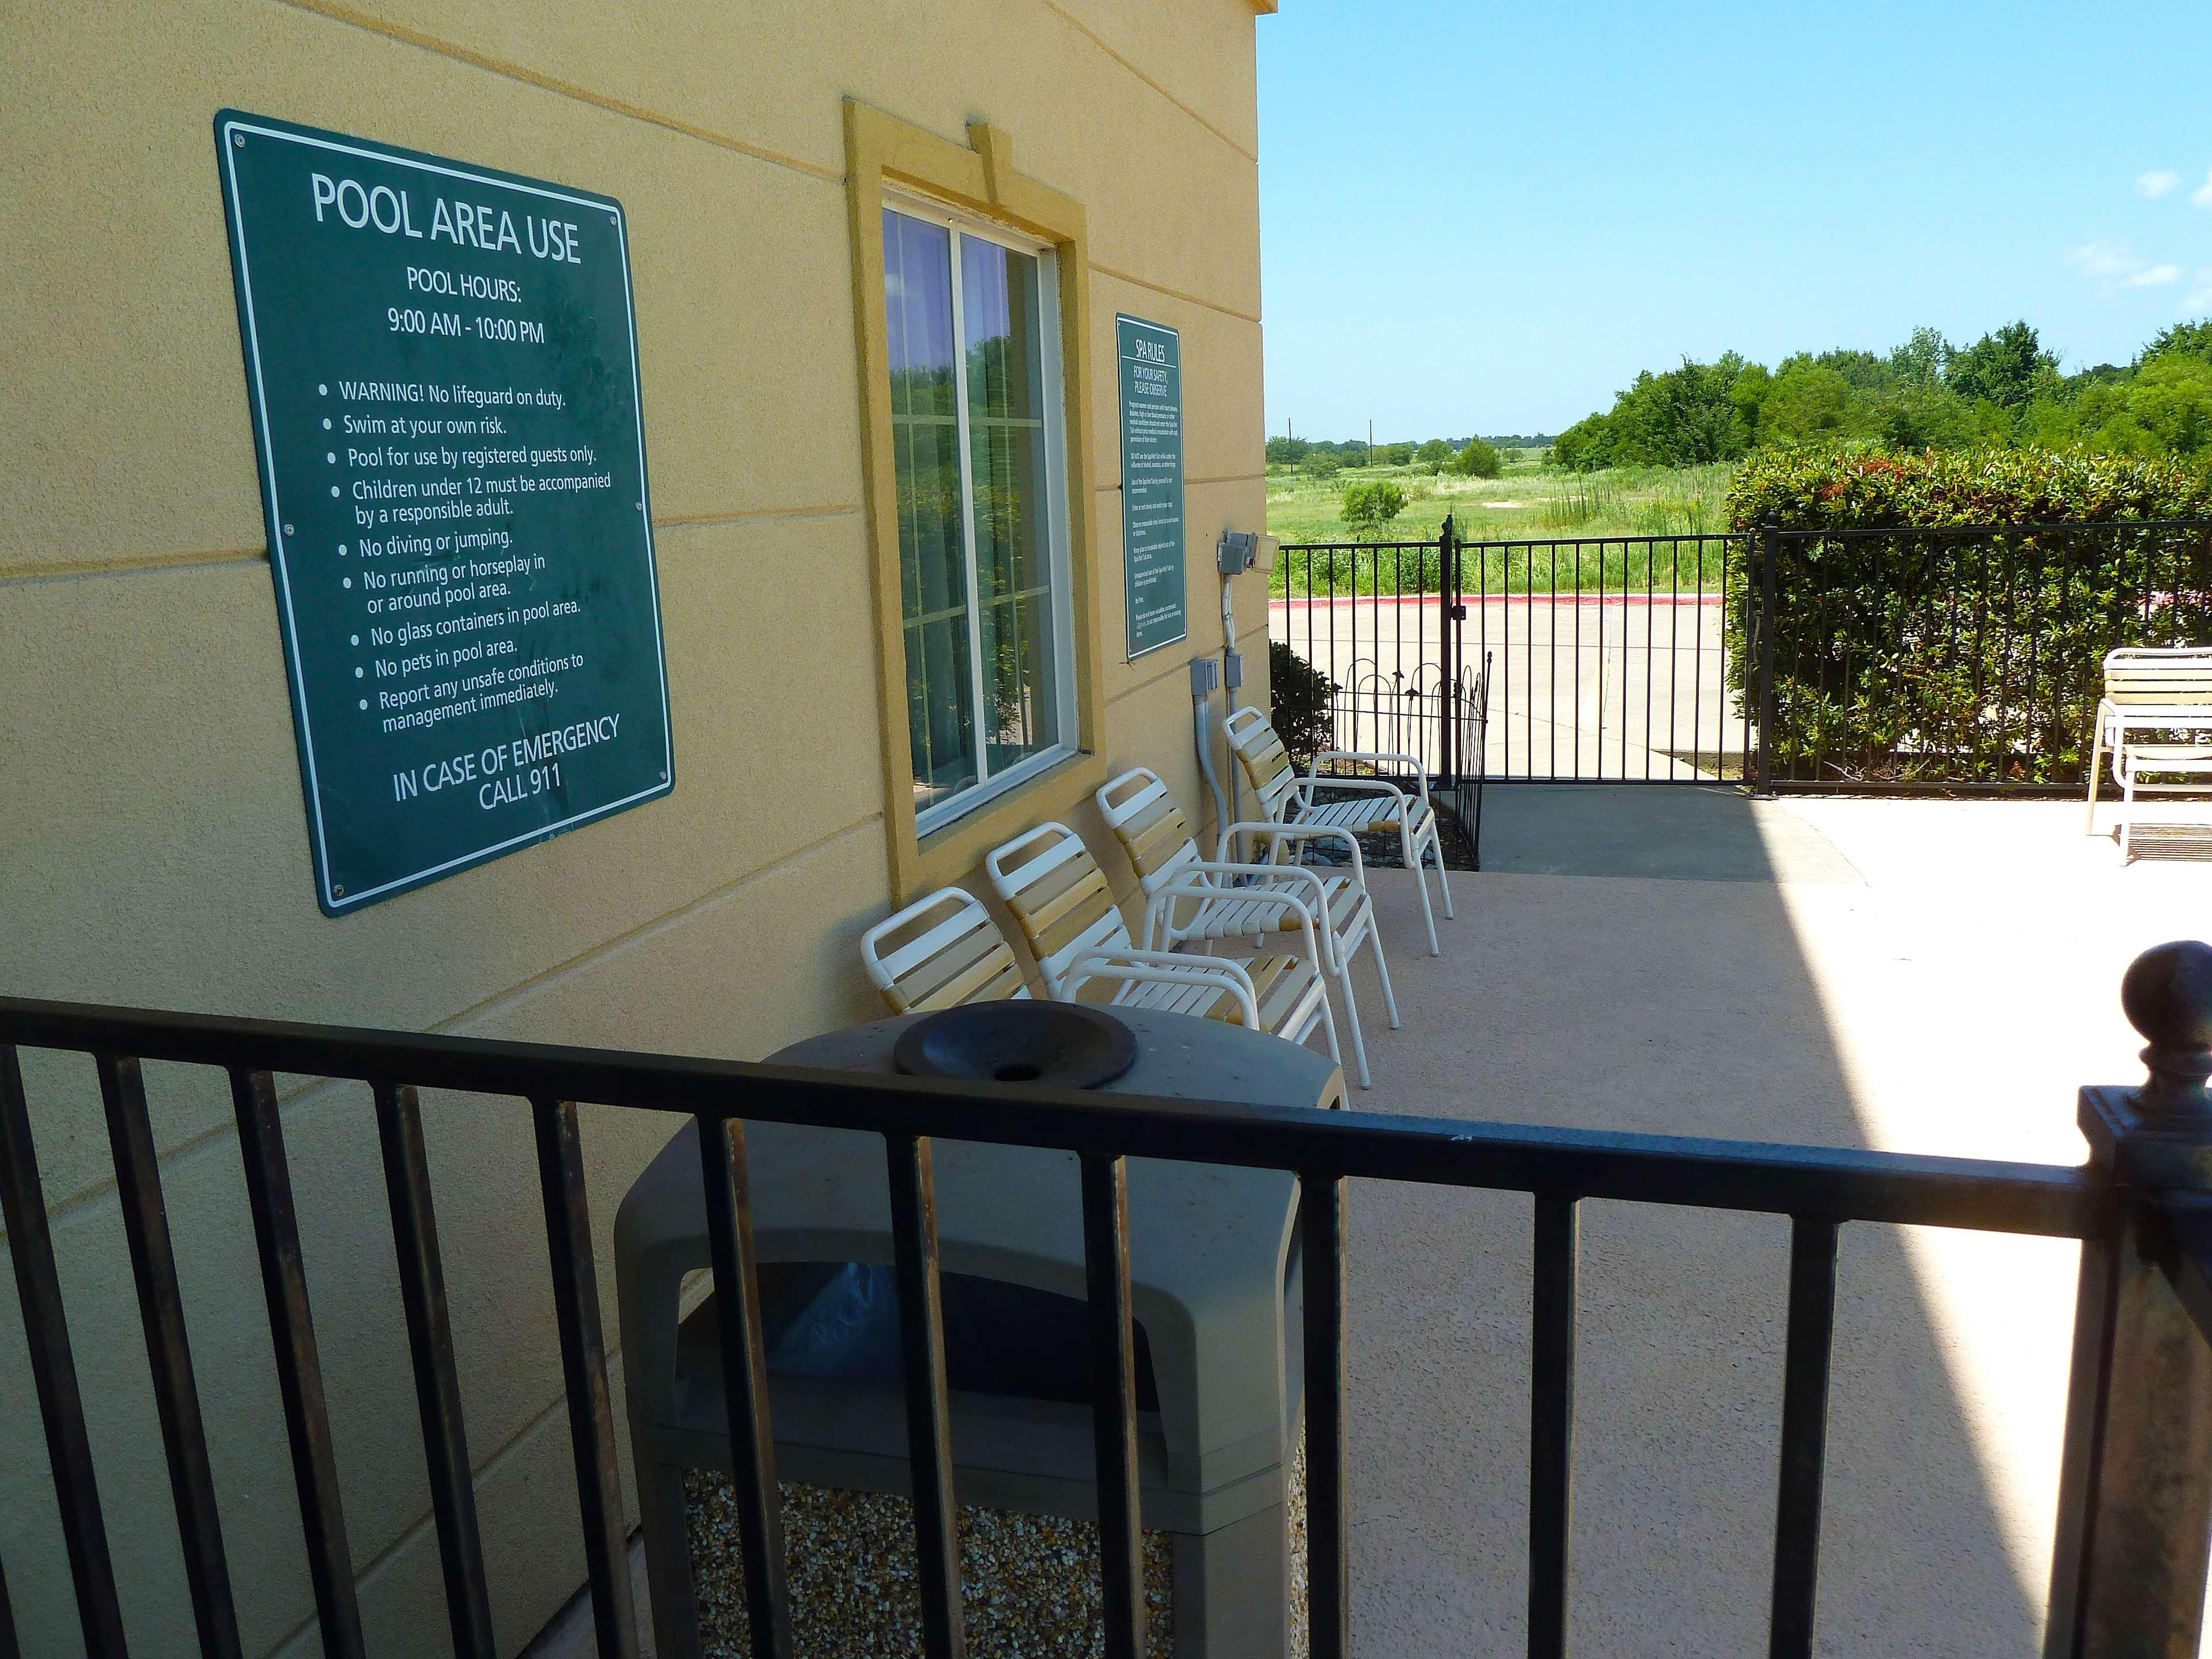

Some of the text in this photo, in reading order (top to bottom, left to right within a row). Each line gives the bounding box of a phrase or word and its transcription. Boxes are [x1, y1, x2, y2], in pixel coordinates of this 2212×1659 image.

[310, 172, 581, 264] POOL AREA USE
[406, 266, 521, 303] POOL HOURS:
[387, 306, 426, 334] 9:00
[429, 312, 461, 337] AM
[475, 316, 517, 342] 10:00
[519, 320, 544, 343] PM
[1135, 339, 1165, 363] SPA RULES
[1134, 365, 1142, 378] FOR
[1135, 380, 1149, 395] PLEASE
[338, 380, 566, 410] WARNING! No lifeguard on duty.
[343, 414, 506, 438] Swim at your own risk.
[347, 444, 596, 469] Pool for use by registered guests only.
[352, 471, 611, 499] Children under 12 must be accompanied
[354, 497, 513, 529] by a responsible adult.
[359, 527, 513, 557] No diving or jumping.
[363, 552, 546, 589] No running or horseplay in
[366, 581, 511, 613] or around pool area.
[370, 600, 581, 646] No glass containers in pool area.
[374, 639, 517, 678] No pets in pool area.
[378, 653, 584, 710] Report any unsafe conditions to
[382, 677, 558, 733] management immediately.
[392, 713, 620, 802] IN CASE OF EMERGENCY
[479, 762, 561, 810] CALL 911
